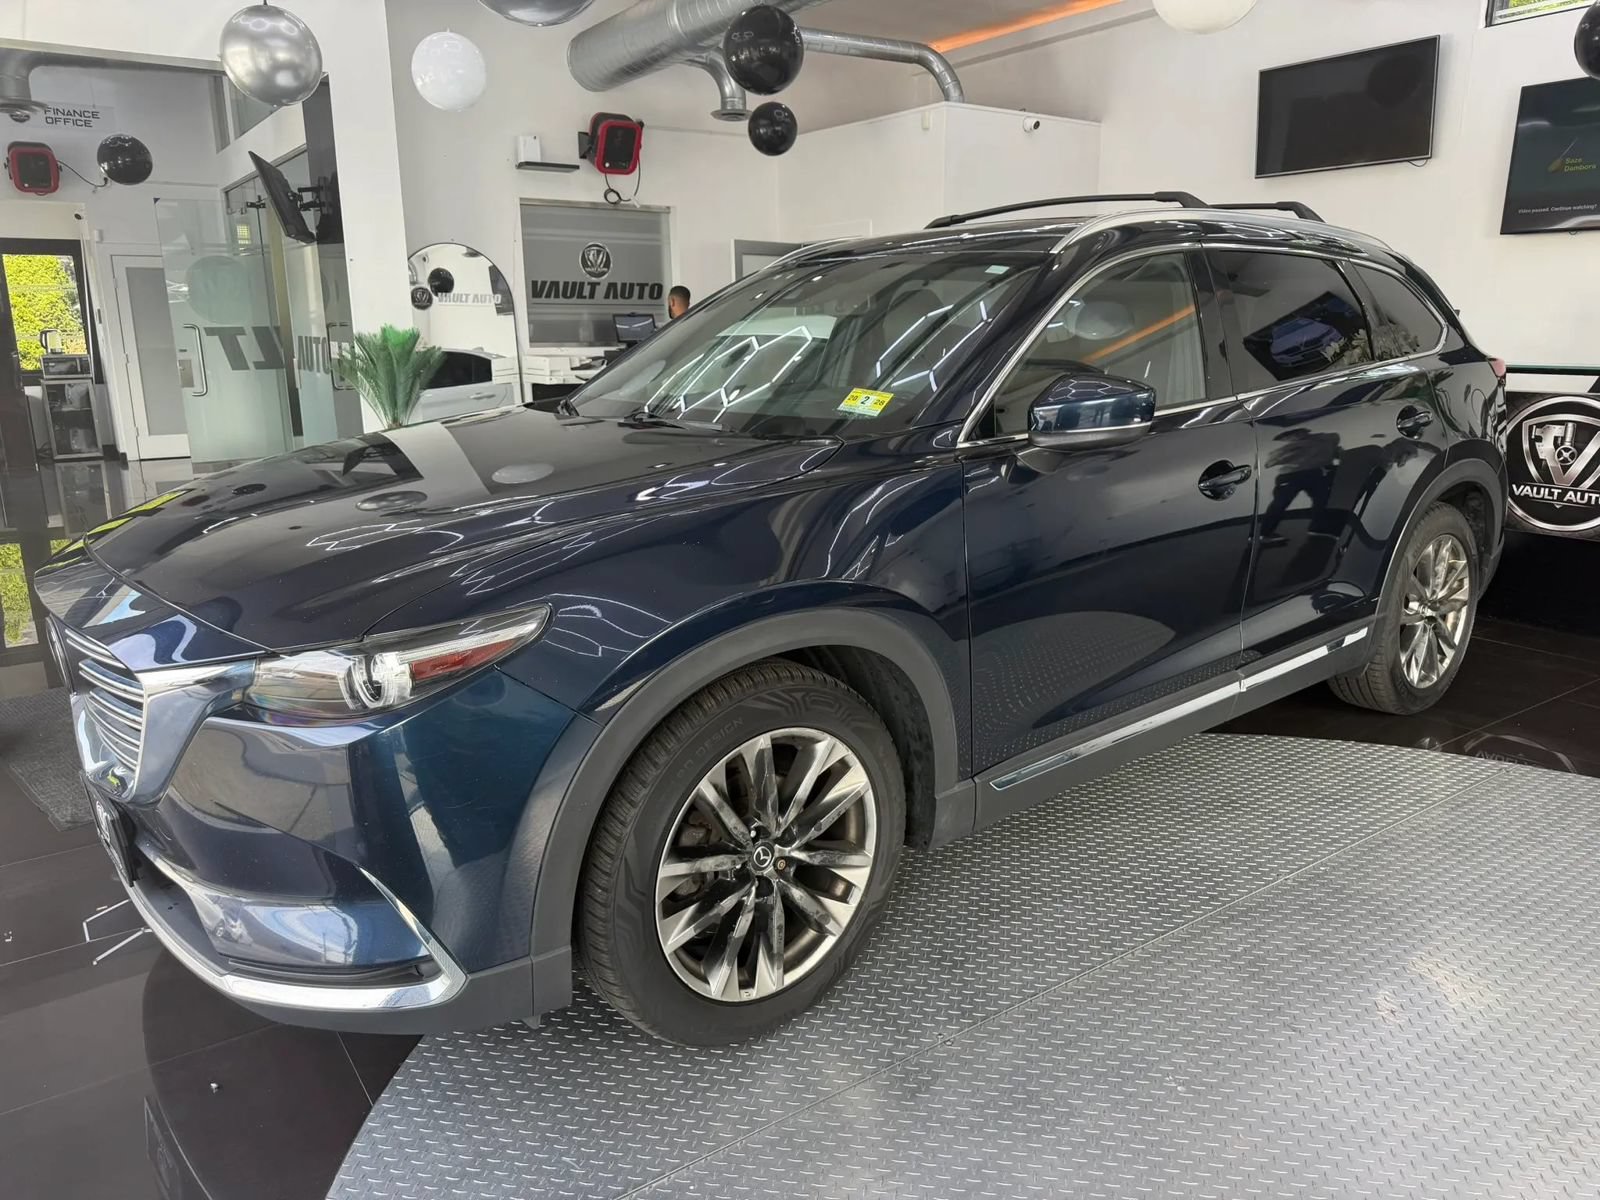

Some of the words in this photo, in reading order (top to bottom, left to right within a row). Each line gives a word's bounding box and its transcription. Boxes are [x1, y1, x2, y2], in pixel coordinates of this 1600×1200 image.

[44, 107, 100, 119] FINANCE
[45, 116, 93, 128] OFFICE
[531, 280, 601, 299] VAULT
[604, 282, 663, 300] AUTO
[472, 293, 502, 304] AUTO
[860, 395, 871, 405] 2
[1511, 483, 1562, 500] VAULT
[1563, 490, 1600, 505] AUT
